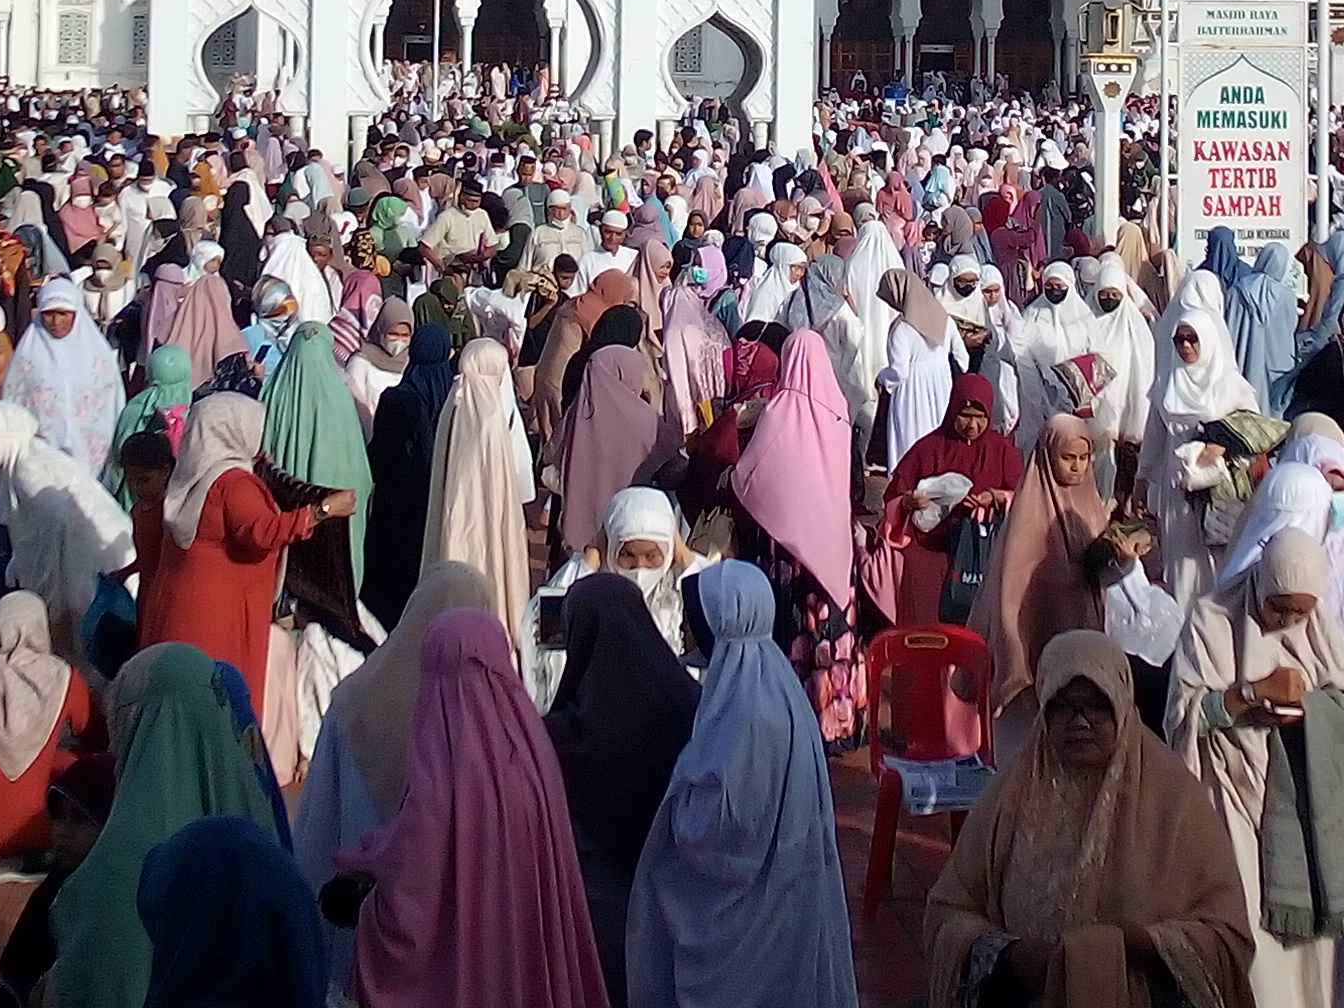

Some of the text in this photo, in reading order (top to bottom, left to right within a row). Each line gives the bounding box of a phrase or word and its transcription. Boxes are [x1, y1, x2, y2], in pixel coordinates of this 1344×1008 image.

[1250, 10, 1279, 20] RAYA
[1220, 86, 1265, 104] ANDA
[1197, 111, 1287, 129] MEMASUKI
[1193, 141, 1290, 162] KAWASAN
[1208, 168, 1277, 189] TERTIB
[1202, 196, 1282, 217] SAMPAH
